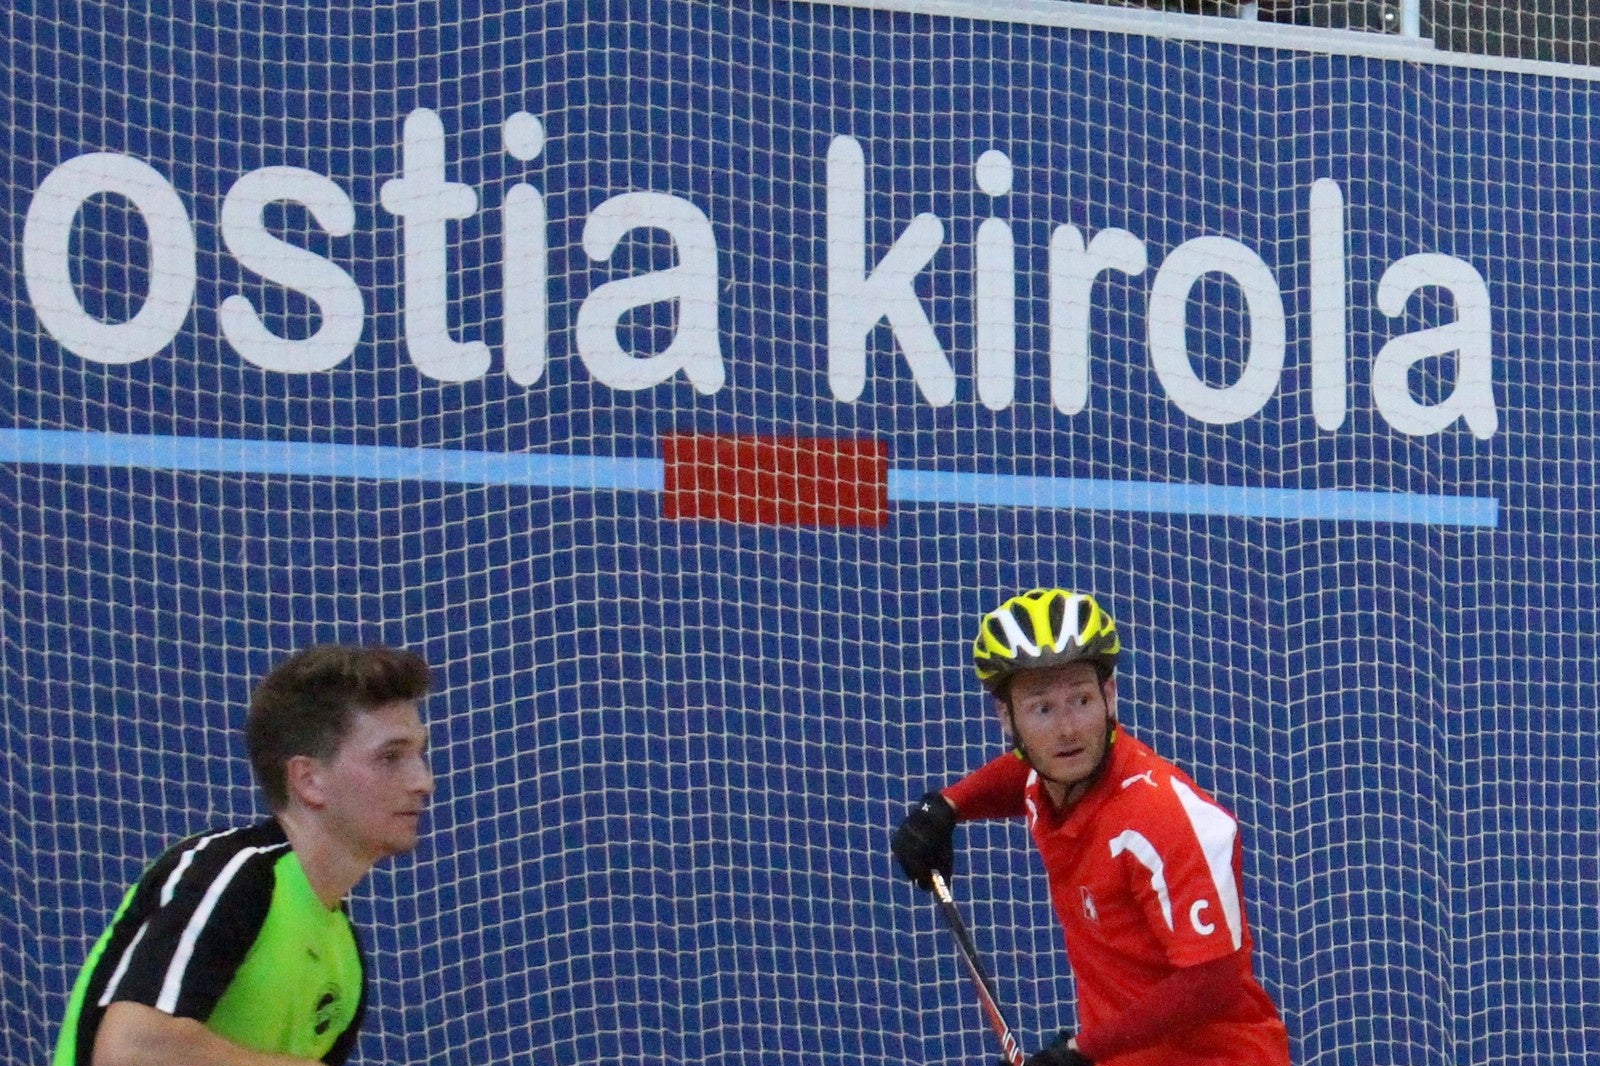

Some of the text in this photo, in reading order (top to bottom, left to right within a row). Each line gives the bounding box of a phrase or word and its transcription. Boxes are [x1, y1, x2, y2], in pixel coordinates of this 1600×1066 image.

[22, 107, 1499, 440] ostia kirola
[1189, 899, 1215, 936] C
